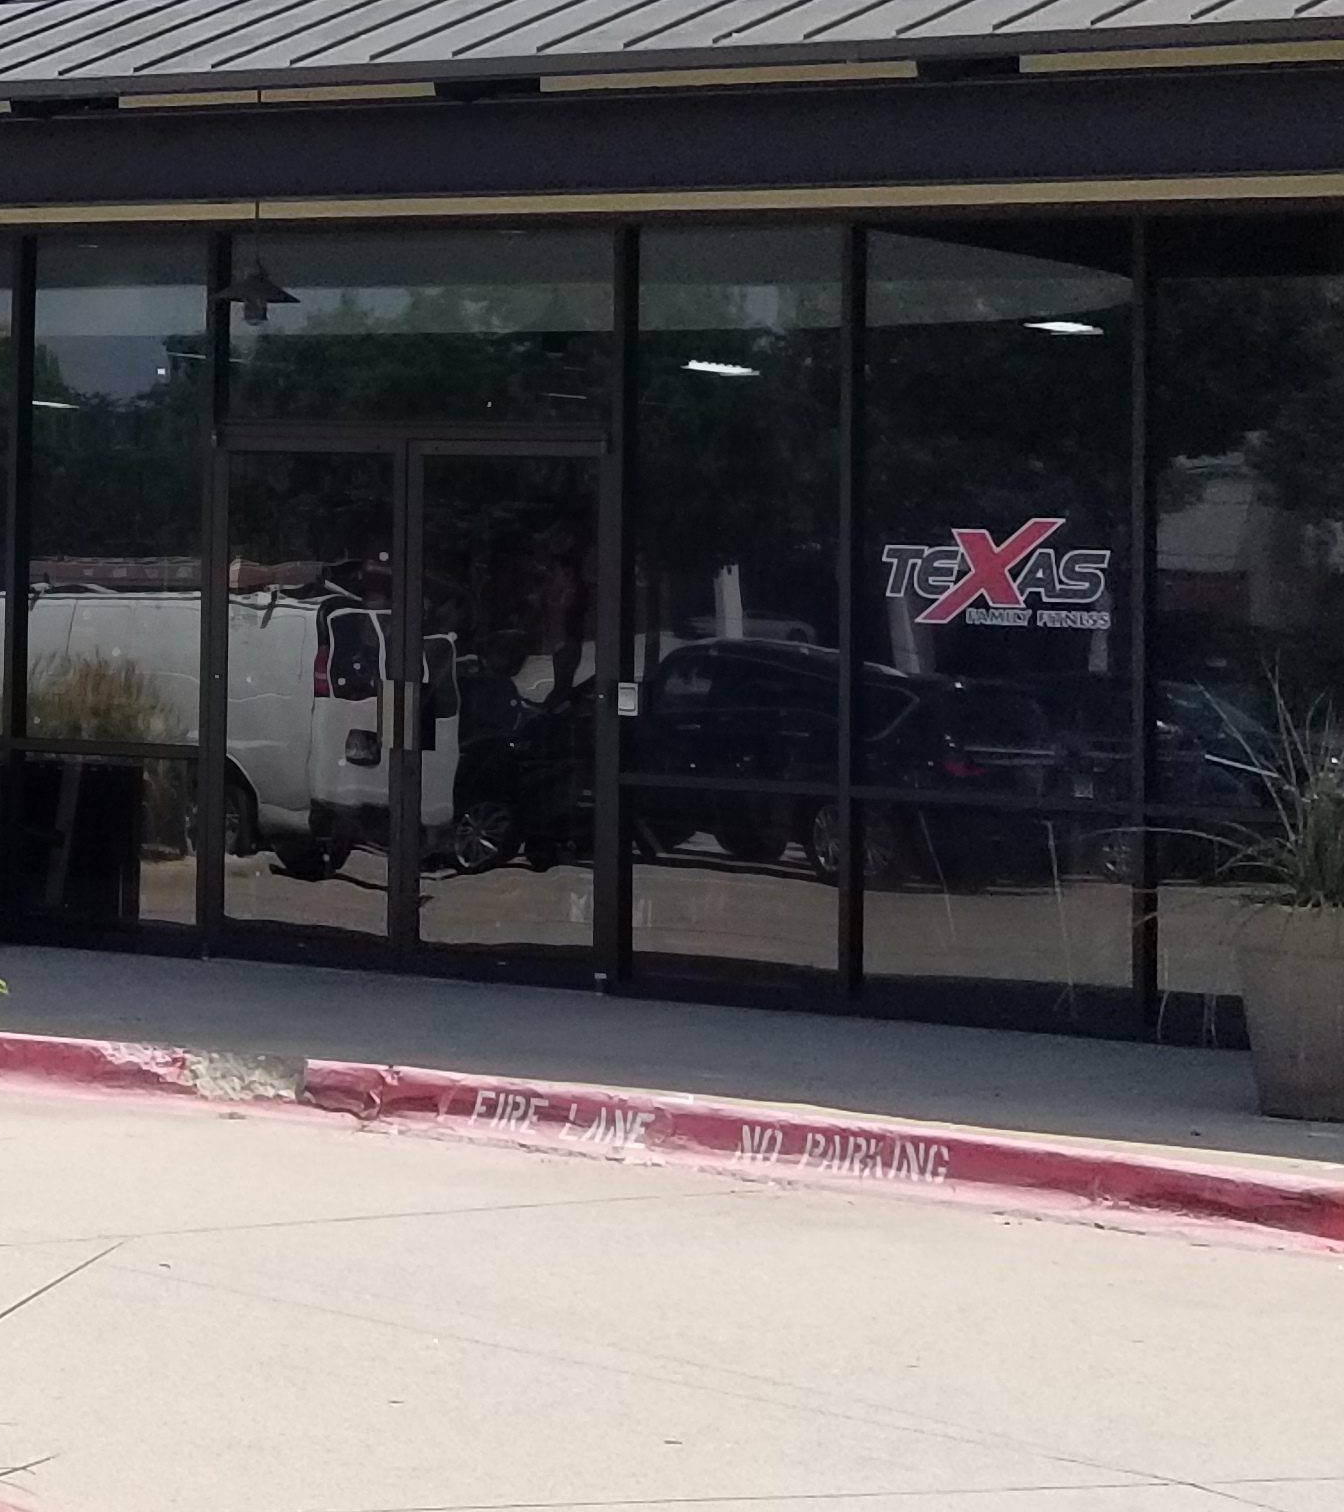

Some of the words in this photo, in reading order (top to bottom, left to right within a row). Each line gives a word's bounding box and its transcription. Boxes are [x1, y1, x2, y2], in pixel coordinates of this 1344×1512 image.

[882, 517, 1111, 624] TEXAS
[468, 1089, 550, 1136] FIRE
[558, 1102, 656, 1149] LANE
[731, 1123, 783, 1167] NO
[797, 1131, 950, 1186] PARKING
